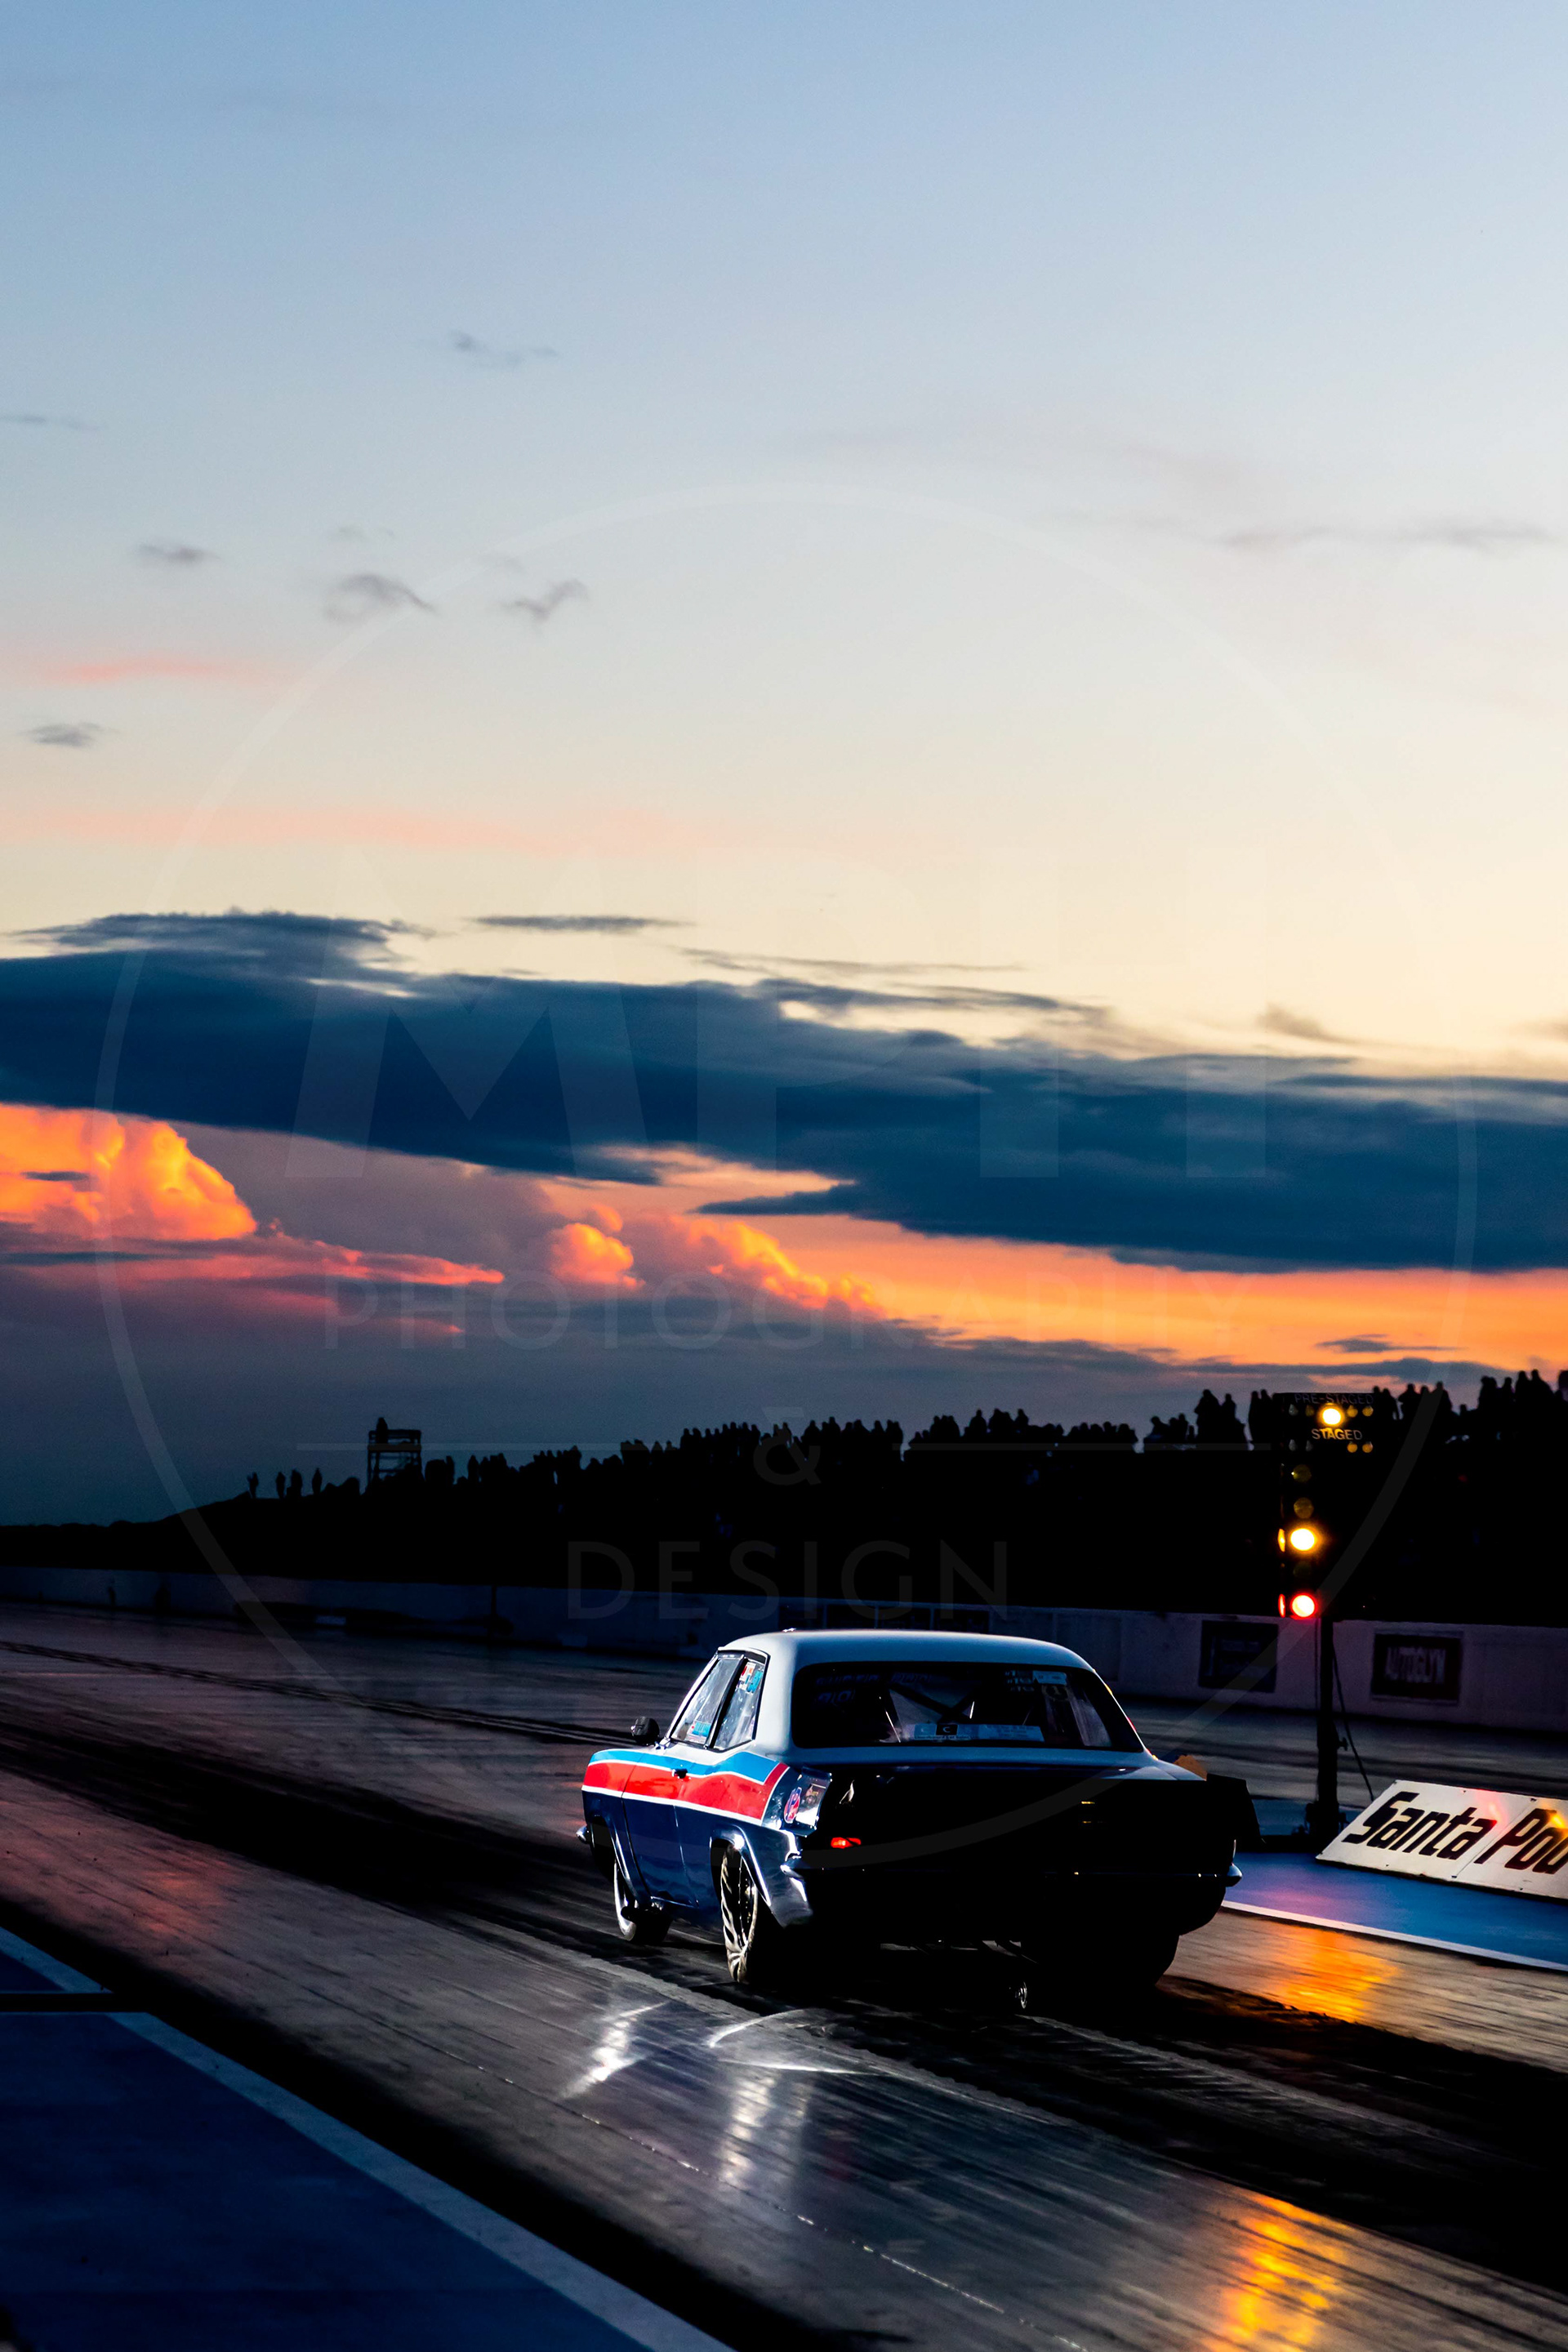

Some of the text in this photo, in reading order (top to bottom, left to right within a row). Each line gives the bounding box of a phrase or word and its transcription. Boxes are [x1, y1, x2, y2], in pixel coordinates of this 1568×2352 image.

[1294, 1393, 1375, 1405] PRE-STAGED
[1311, 1428, 1363, 1440] STAGED
[1341, 1791, 1497, 1860] Santa
